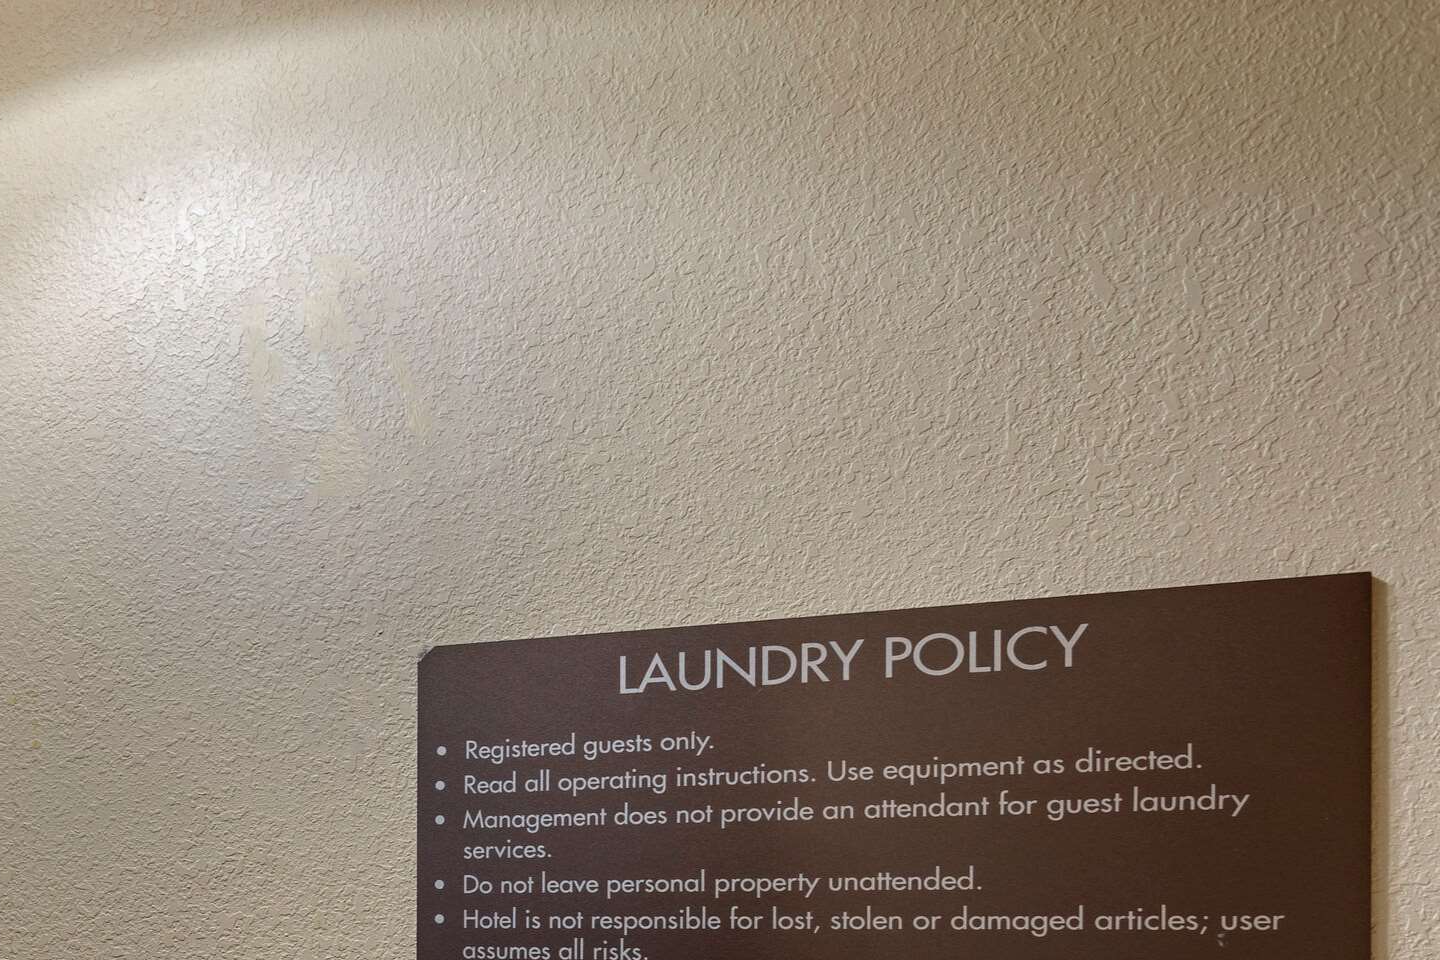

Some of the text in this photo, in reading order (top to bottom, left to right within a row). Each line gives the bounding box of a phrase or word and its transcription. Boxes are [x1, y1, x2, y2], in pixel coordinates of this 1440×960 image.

[619, 622, 1089, 695] LAUNDRY POLICY
[465, 730, 715, 765] Registered guests only.
[464, 742, 1203, 797] Read all operating instructions. Use equipment as directed.
[462, 783, 1251, 834] Management does not provide an attendant for guest laundry
[463, 840, 552, 860] services.
[463, 864, 983, 900] Do not leave personal property unattended.
[463, 904, 1286, 938] Hotel is not responsible for lost, stolen or damaged articles; user
[462, 945, 551, 960] assumes
[558, 936, 585, 960] all
